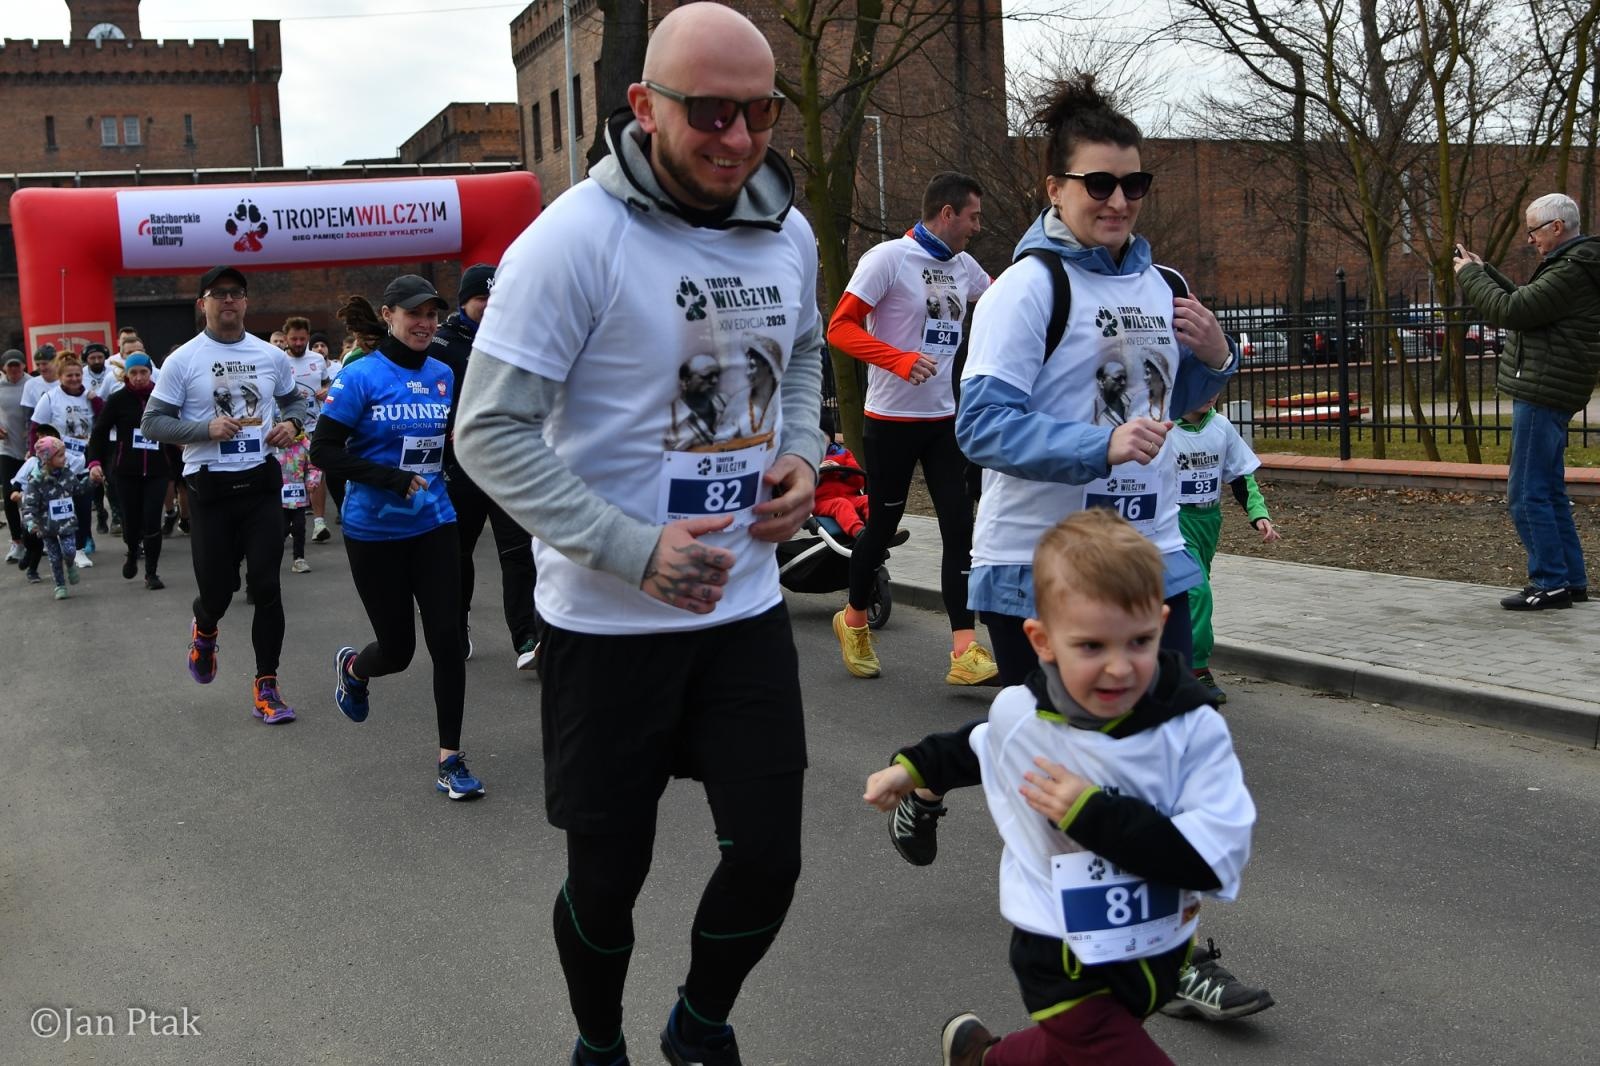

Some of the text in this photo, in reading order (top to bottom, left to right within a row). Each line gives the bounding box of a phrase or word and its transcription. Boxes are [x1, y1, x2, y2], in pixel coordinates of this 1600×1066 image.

[150, 213, 200, 224] Raciborskie
[152, 235, 184, 247] Kultury
[313, 233, 344, 241] PAMIĘCI
[704, 276, 743, 290] TROPEM
[710, 286, 782, 309] WILCZYM
[1117, 306, 1143, 315] TROPEM
[735, 316, 766, 330] EDYCJA
[766, 314, 787, 327] 2026
[1121, 315, 1167, 330] WILCZYM
[938, 331, 951, 345] 94
[227, 364, 256, 373] WILCZYM
[238, 440, 247, 453] 8
[422, 449, 431, 463] 7
[1191, 454, 1219, 466] WILCZYM
[716, 460, 747, 473] WILCZYM
[1121, 483, 1146, 492] WILCZYM
[1195, 480, 1211, 494] 93
[704, 479, 742, 512] 82
[1113, 496, 1141, 520] 16
[1105, 883, 1150, 926] 81
